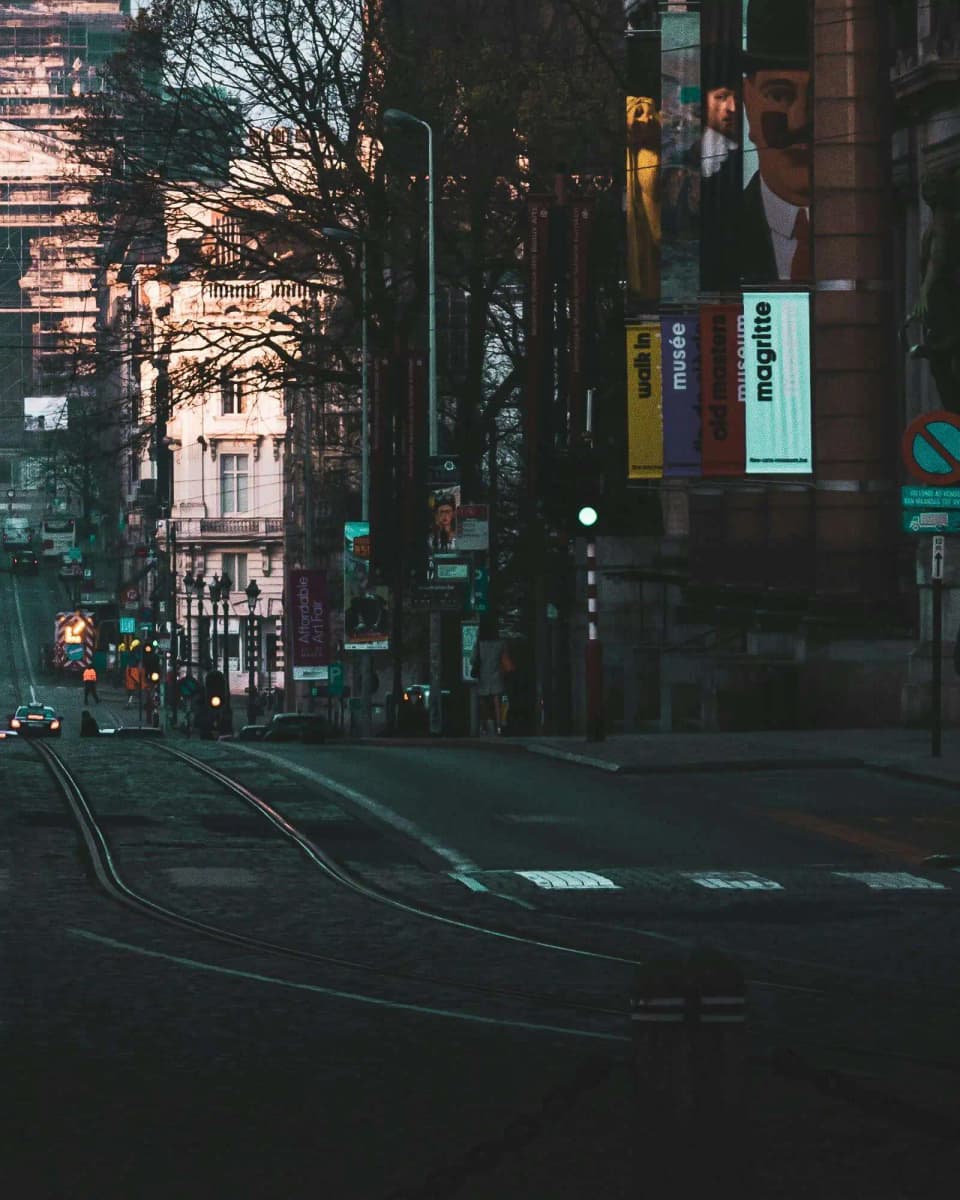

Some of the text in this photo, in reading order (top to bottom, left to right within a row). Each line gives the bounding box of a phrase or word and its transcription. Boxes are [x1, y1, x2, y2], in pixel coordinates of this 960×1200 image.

[634, 332, 652, 399] walk in
[668, 322, 687, 390] musée
[708, 314, 728, 441] old masters
[751, 301, 777, 402] magritte
[296, 576, 311, 644] Affordable
[310, 600, 324, 622] Fair
[311, 624, 324, 644] Art
